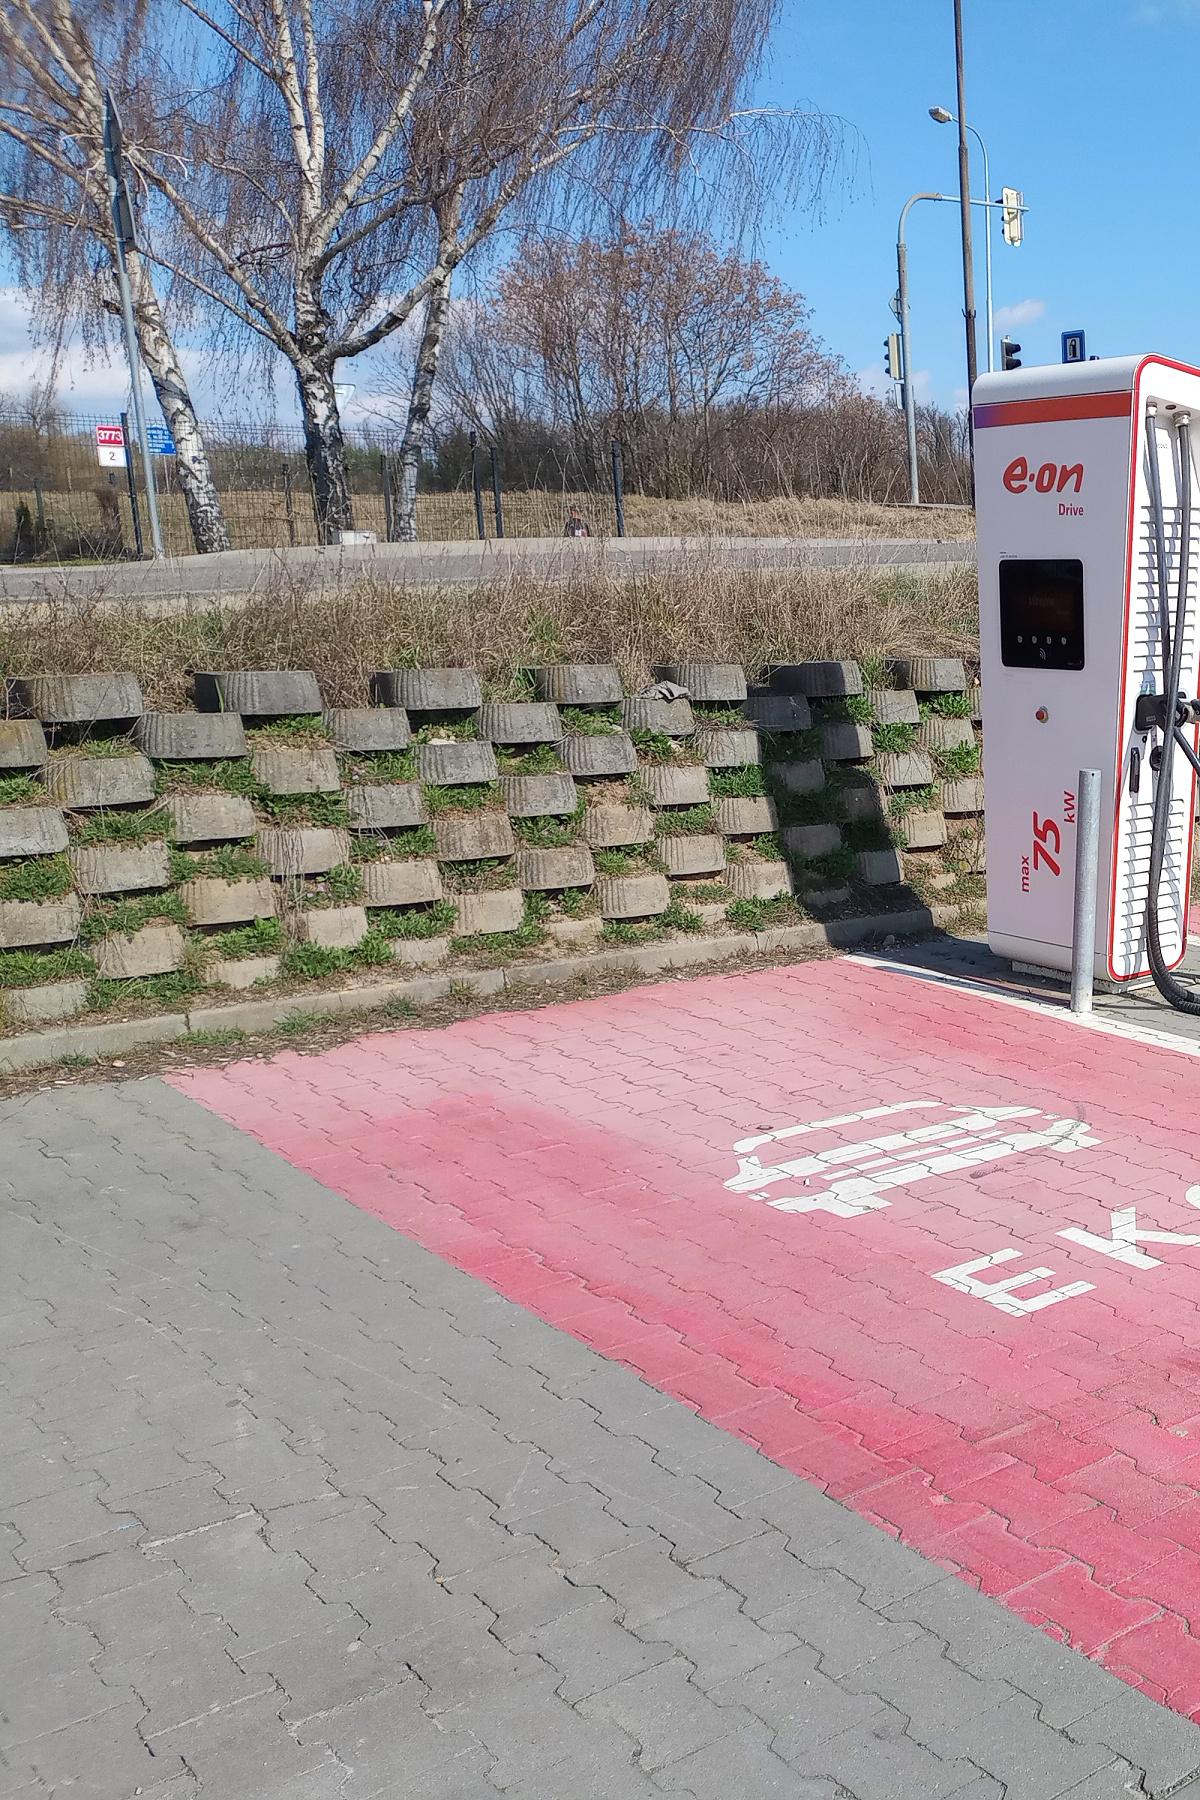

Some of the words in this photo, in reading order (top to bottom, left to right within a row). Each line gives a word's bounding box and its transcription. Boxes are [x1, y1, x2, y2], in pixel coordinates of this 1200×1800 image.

[98, 430, 122, 441] 3773
[109, 451, 115, 460] 2
[1058, 502, 1084, 516] Drive
[1021, 856, 1030, 893] max
[1033, 811, 1061, 877] 75
[1063, 790, 1075, 823] kW
